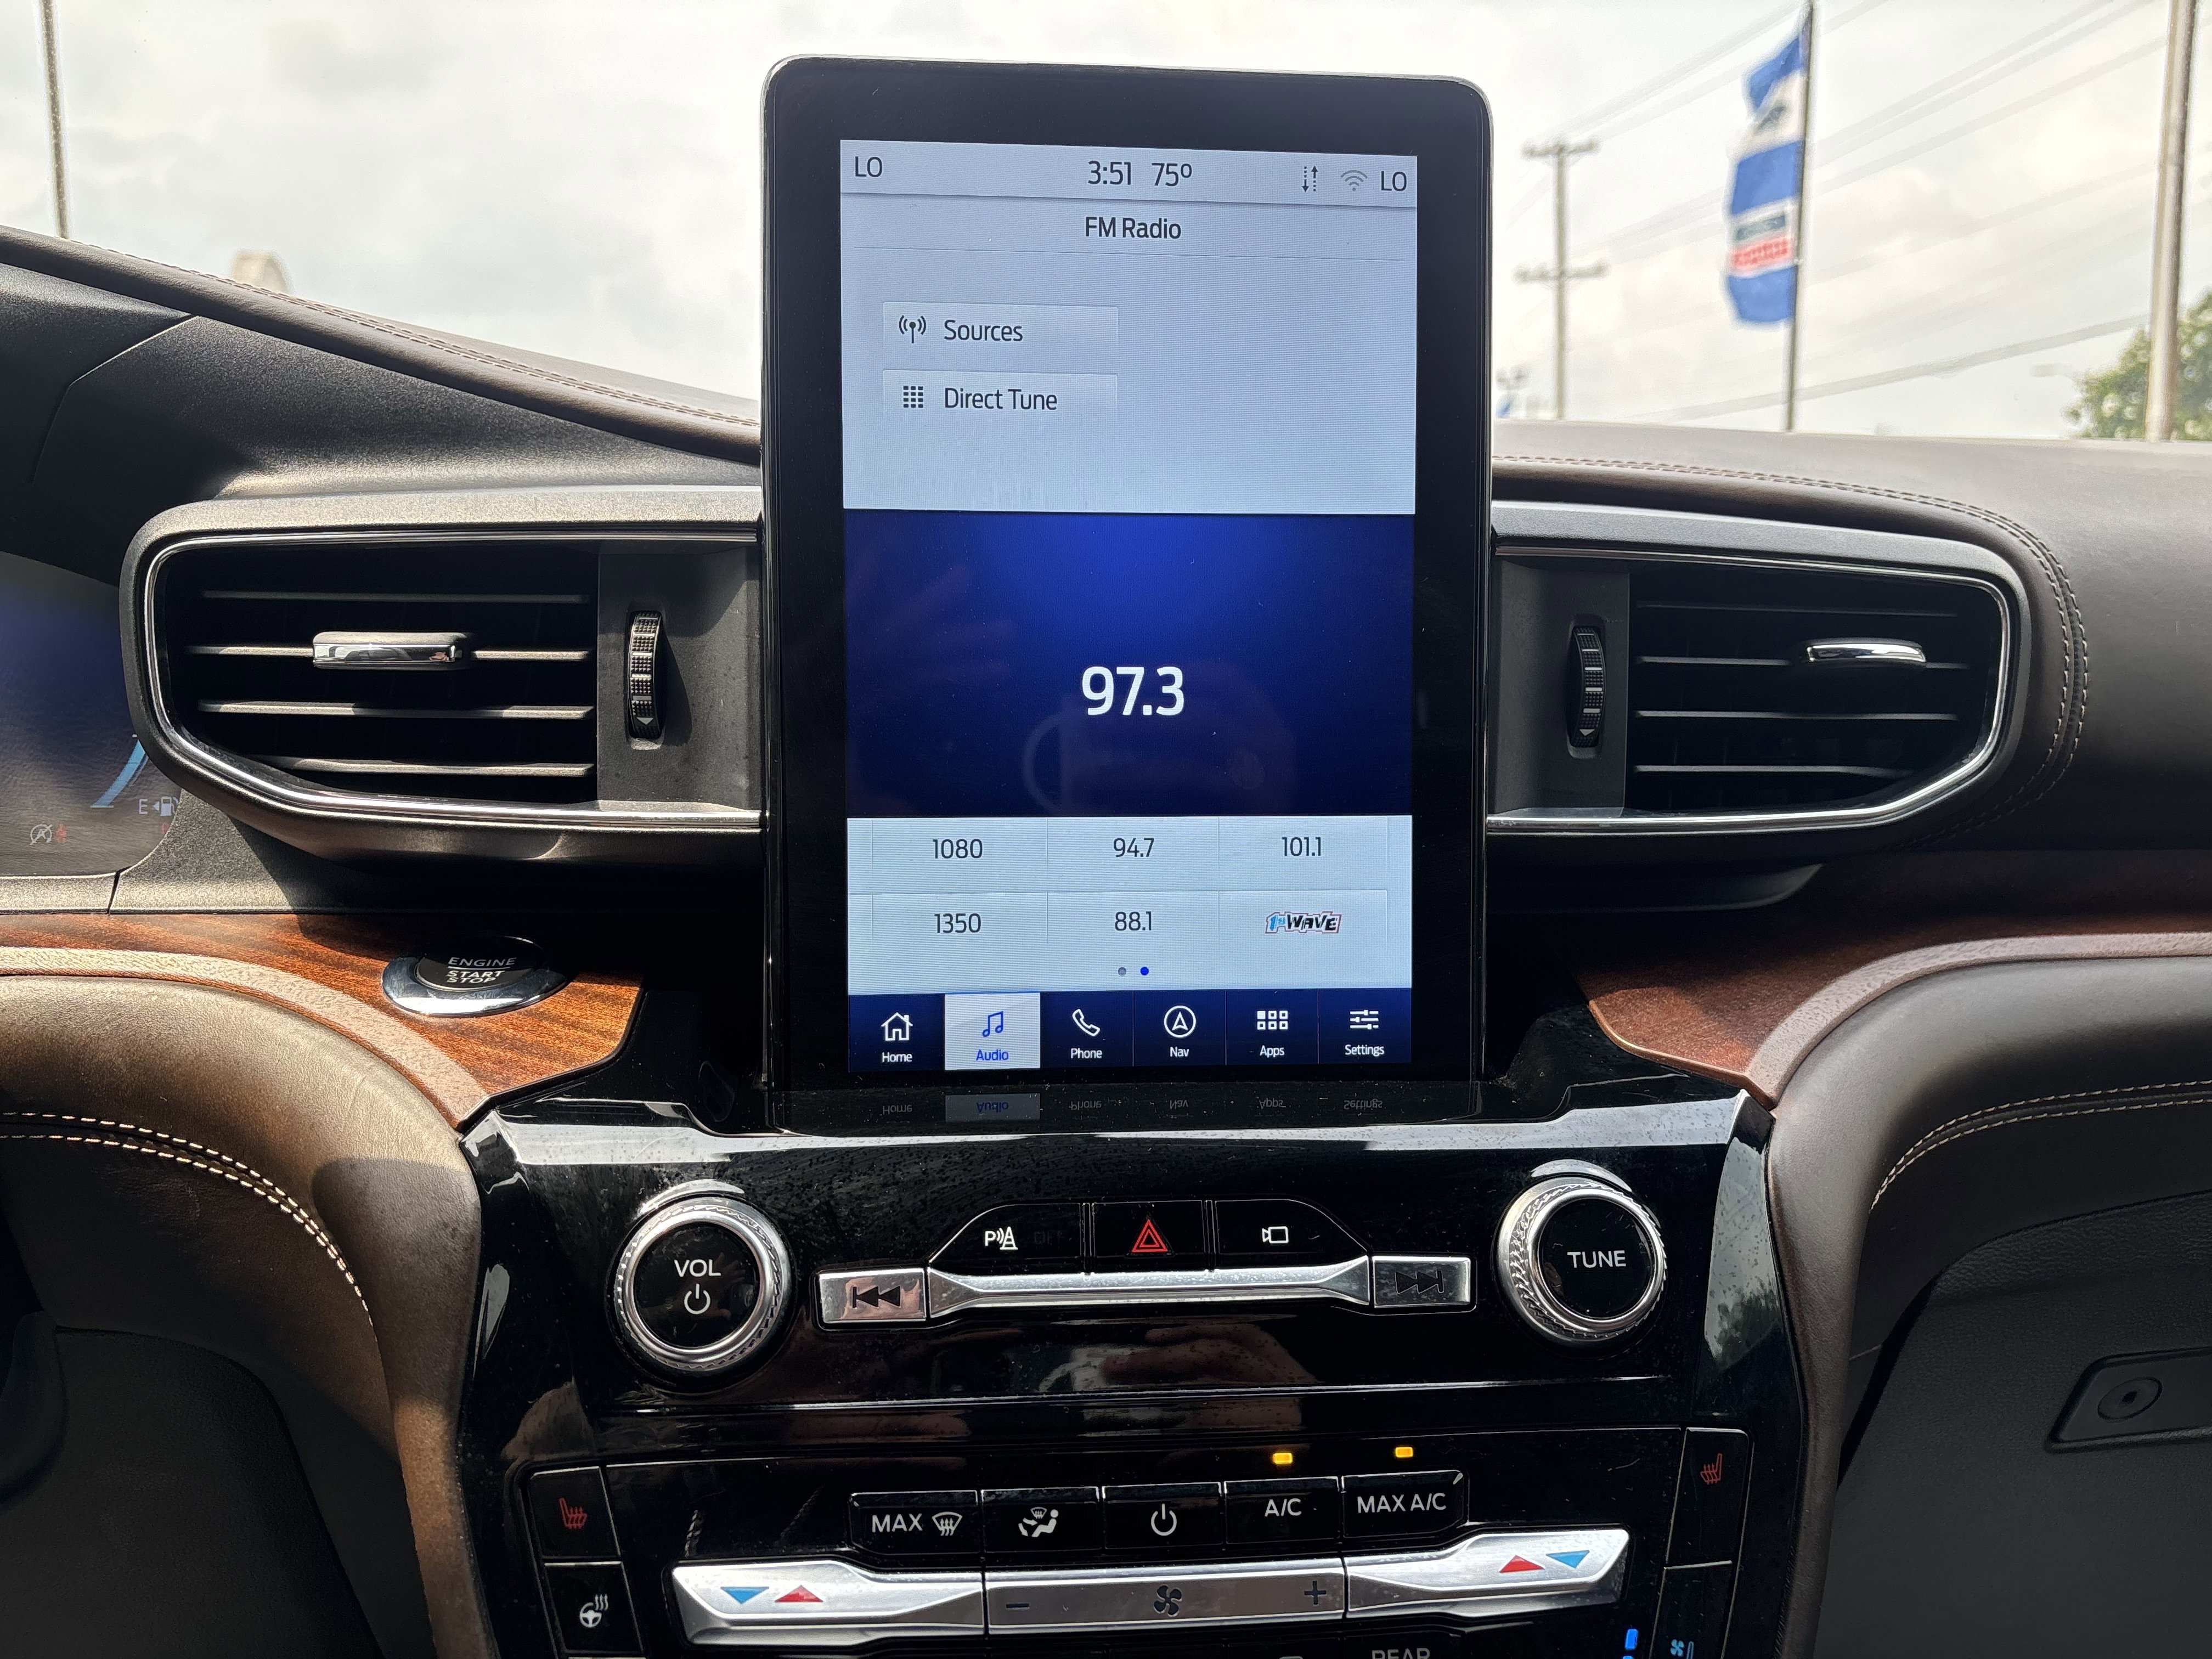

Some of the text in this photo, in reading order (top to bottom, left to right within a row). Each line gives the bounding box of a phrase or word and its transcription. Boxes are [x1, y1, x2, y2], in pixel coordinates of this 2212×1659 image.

[854, 156, 883, 178] LO
[1087, 161, 1132, 186] 3:51
[1380, 170, 1408, 192] LO
[1085, 216, 1182, 240] FM Radio
[943, 318, 1024, 342] Sources
[944, 387, 1058, 411] Direct Tune
[1081, 665, 1185, 716] 97.3
[932, 838, 983, 860] 1080
[1113, 837, 1155, 858] 94.7
[1280, 836, 1323, 857] 101.1
[933, 912, 982, 934] 1350
[1114, 910, 1153, 932] 88.1
[447, 957, 517, 967] ENGINE
[882, 1051, 913, 1063] Home
[975, 1048, 1009, 1062] Audio
[1070, 1047, 1103, 1059] Phone
[1169, 1046, 1190, 1058] Nav
[1259, 1044, 1285, 1058] Apps
[1344, 1043, 1385, 1058] Settings
[673, 1259, 722, 1278] VOL
[1566, 1249, 1627, 1269] TUNE
[1264, 1497, 1302, 1517] A/C
[1357, 1492, 1447, 1514] MAX A/C
[871, 1513, 923, 1533] MAX
